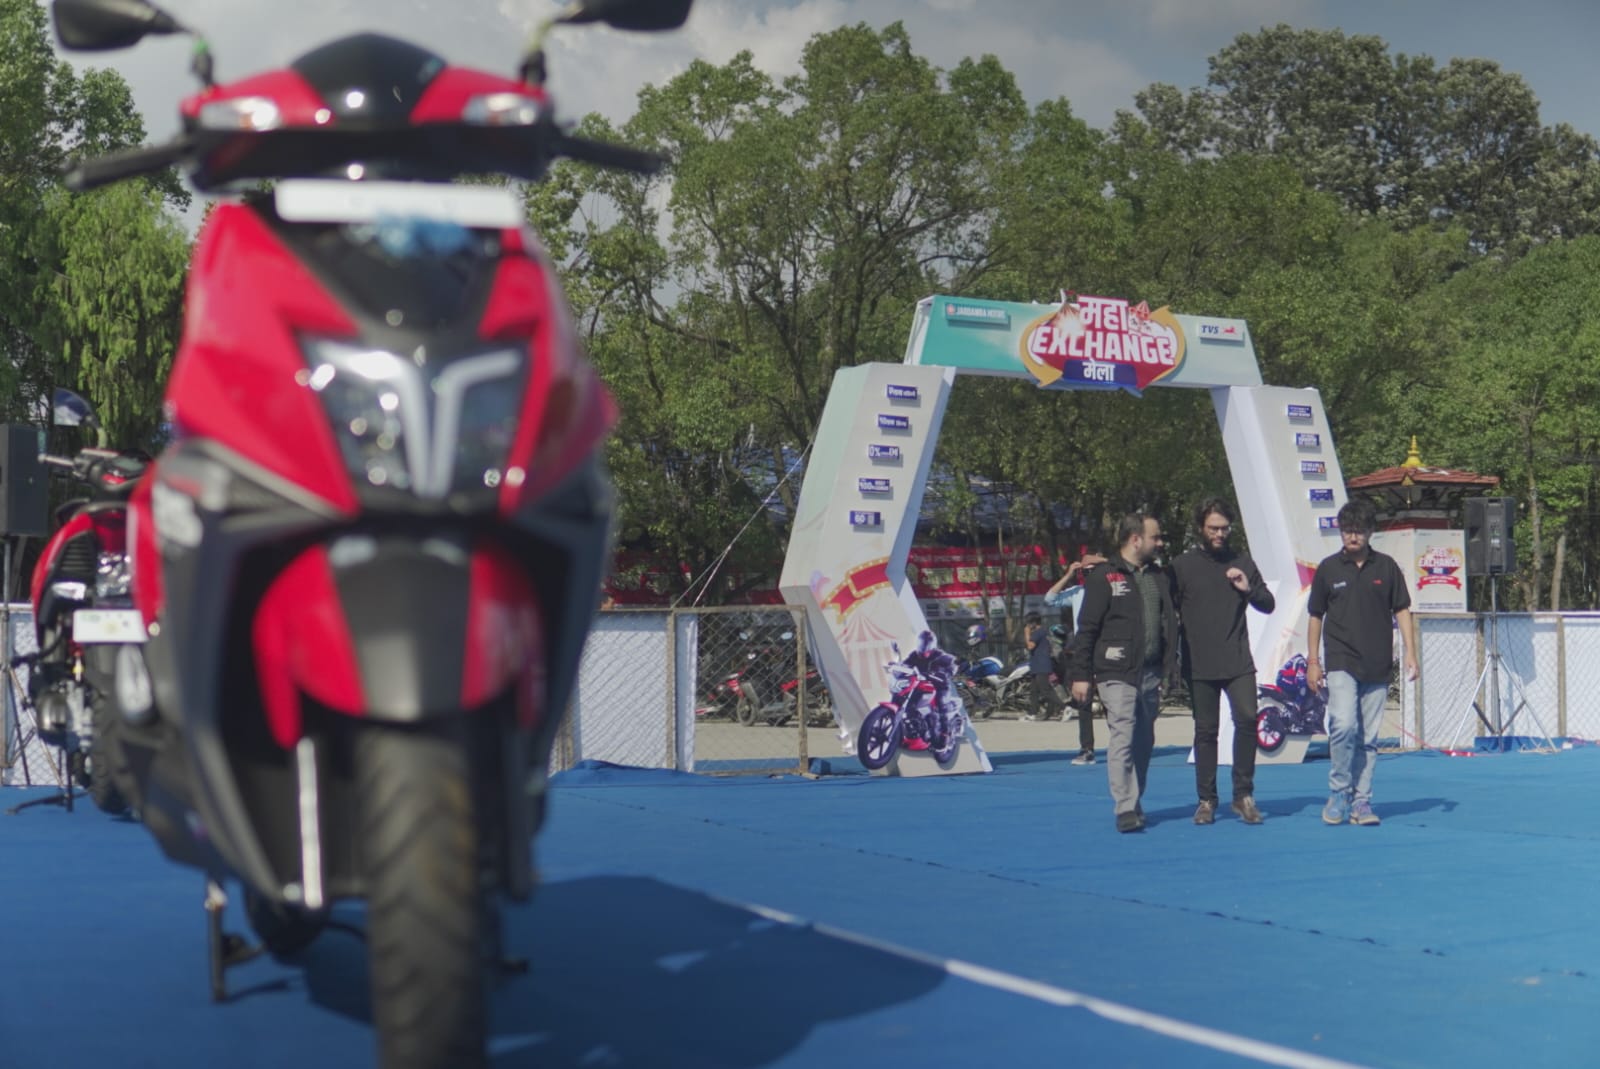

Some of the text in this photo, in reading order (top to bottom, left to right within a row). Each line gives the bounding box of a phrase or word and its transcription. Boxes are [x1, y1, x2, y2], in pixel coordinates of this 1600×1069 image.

[1078, 295, 1129, 332] महा
[1032, 324, 1175, 366] EXCHANGE
[1201, 324, 1220, 335] TVS
[1082, 357, 1116, 382] मेला
